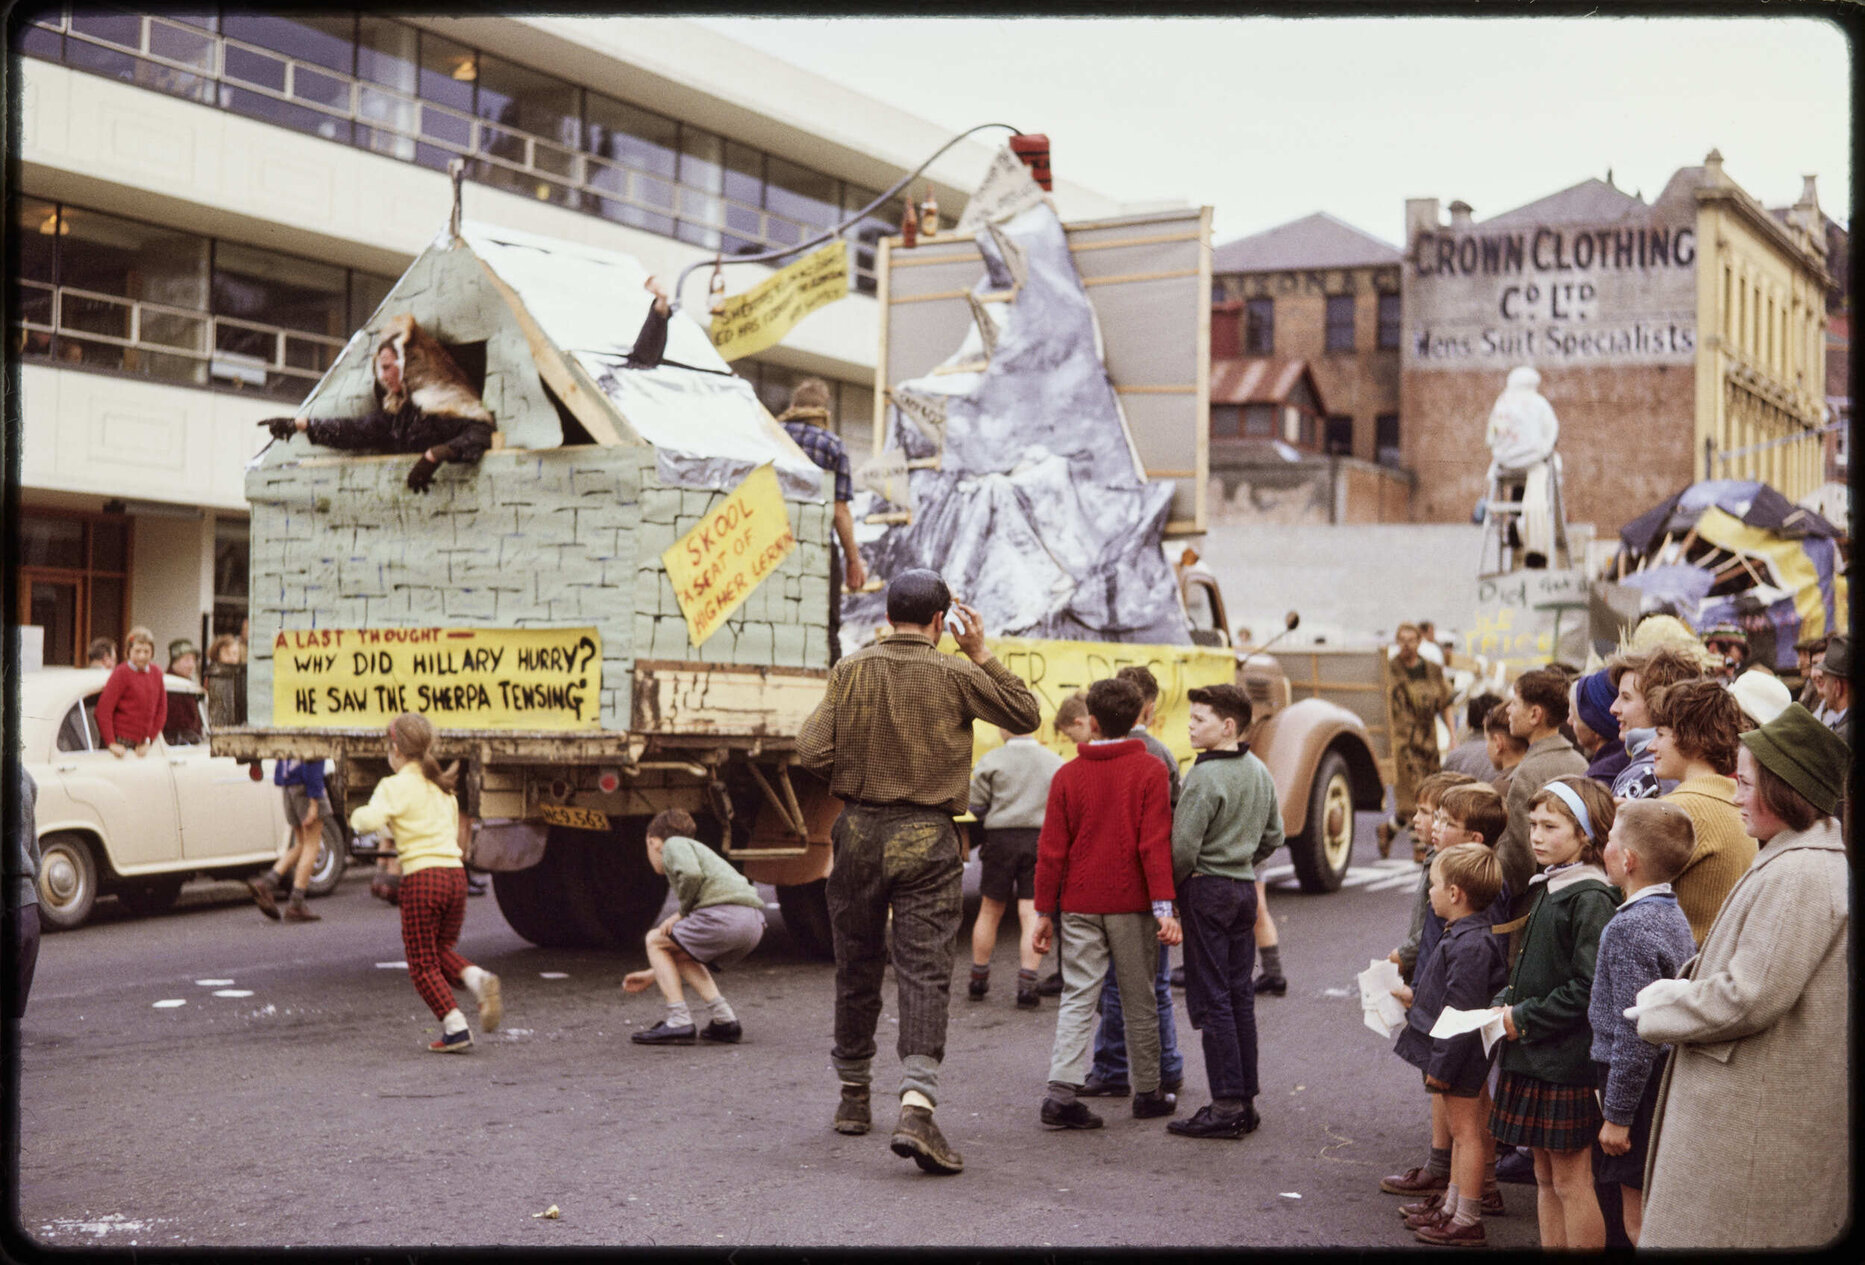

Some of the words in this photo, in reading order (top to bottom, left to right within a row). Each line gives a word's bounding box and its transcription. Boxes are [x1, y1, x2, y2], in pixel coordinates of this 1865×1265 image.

[1412, 230, 1524, 276] CROWN
[1531, 227, 1695, 272] CLOTHING
[1482, 327, 1534, 356] Suit
[1547, 323, 1693, 355] Specialists
[687, 498, 755, 566] SKOOL
[693, 551, 727, 596] SEAT
[733, 526, 754, 556] OF
[693, 572, 748, 636] HIGHER
[275, 630, 288, 649] A
[296, 629, 345, 649] LAST
[357, 627, 443, 646] THOUGHT
[294, 653, 337, 674] WHY
[354, 651, 393, 676] DID
[413, 647, 504, 674] HILLARY
[518, 636, 597, 688] HURRY?
[296, 687, 317, 714] HE
[327, 687, 367, 713] SAW
[377, 684, 409, 714] THE
[418, 683, 491, 713] SHERPA
[499, 680, 585, 721] TENSING
